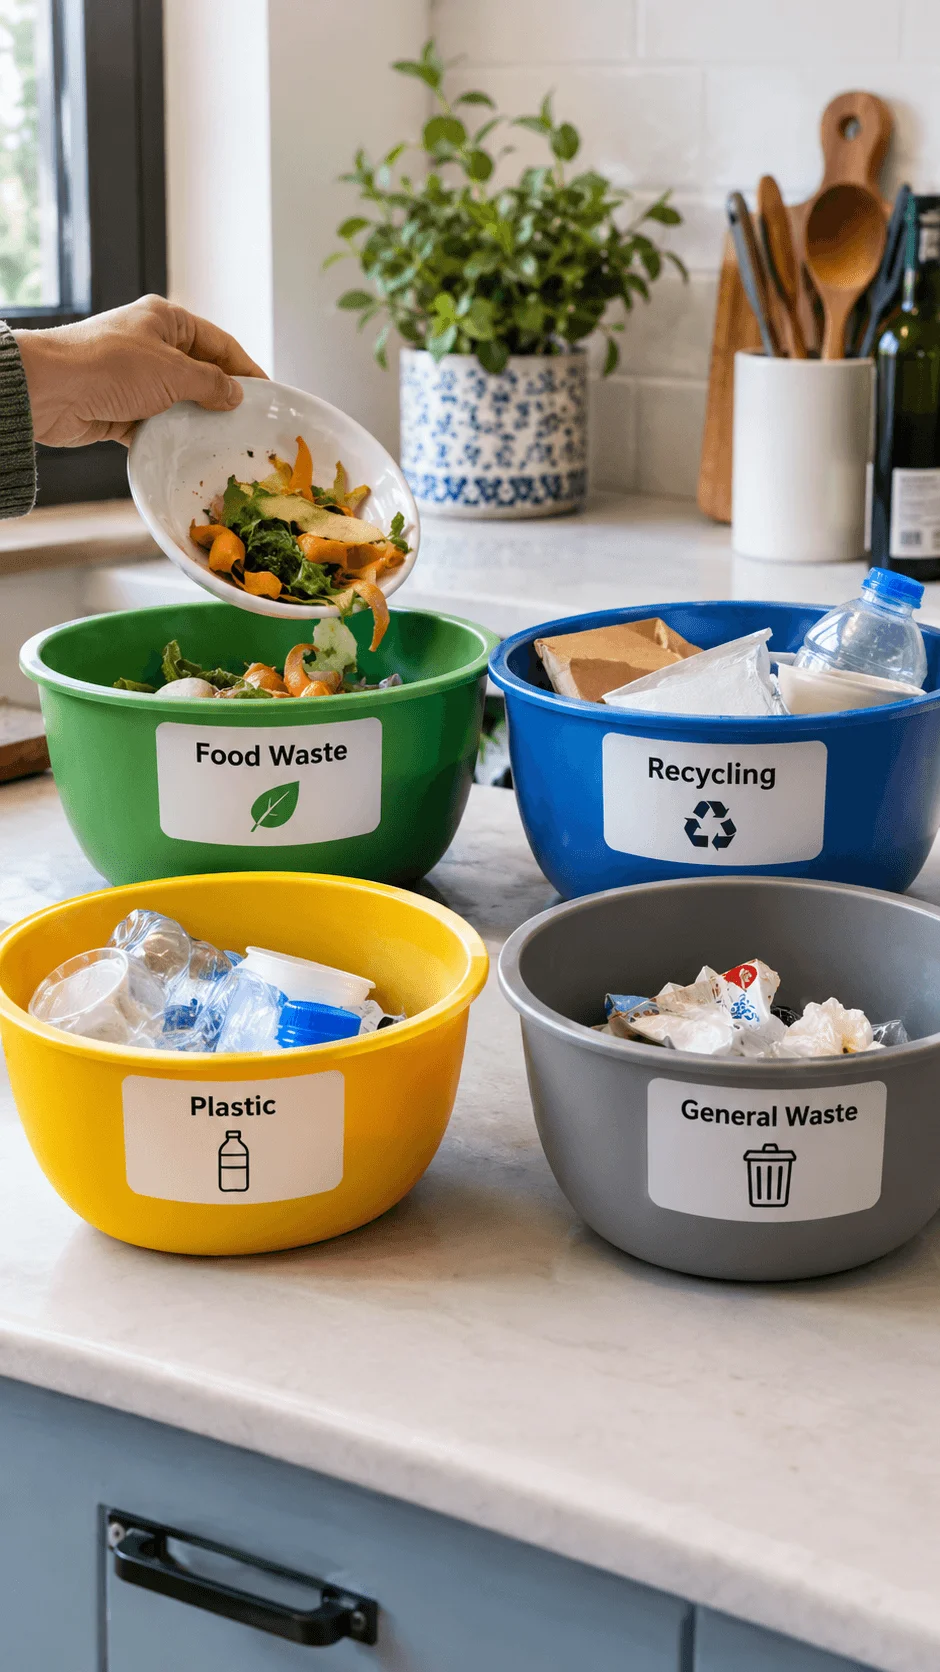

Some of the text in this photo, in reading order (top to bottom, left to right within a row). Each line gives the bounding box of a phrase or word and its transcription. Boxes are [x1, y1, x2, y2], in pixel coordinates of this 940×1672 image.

[195, 742, 348, 767] Food Waste
[648, 757, 777, 790] Recycling
[190, 1094, 277, 1118] Plastic
[681, 1099, 858, 1127] General Waste
